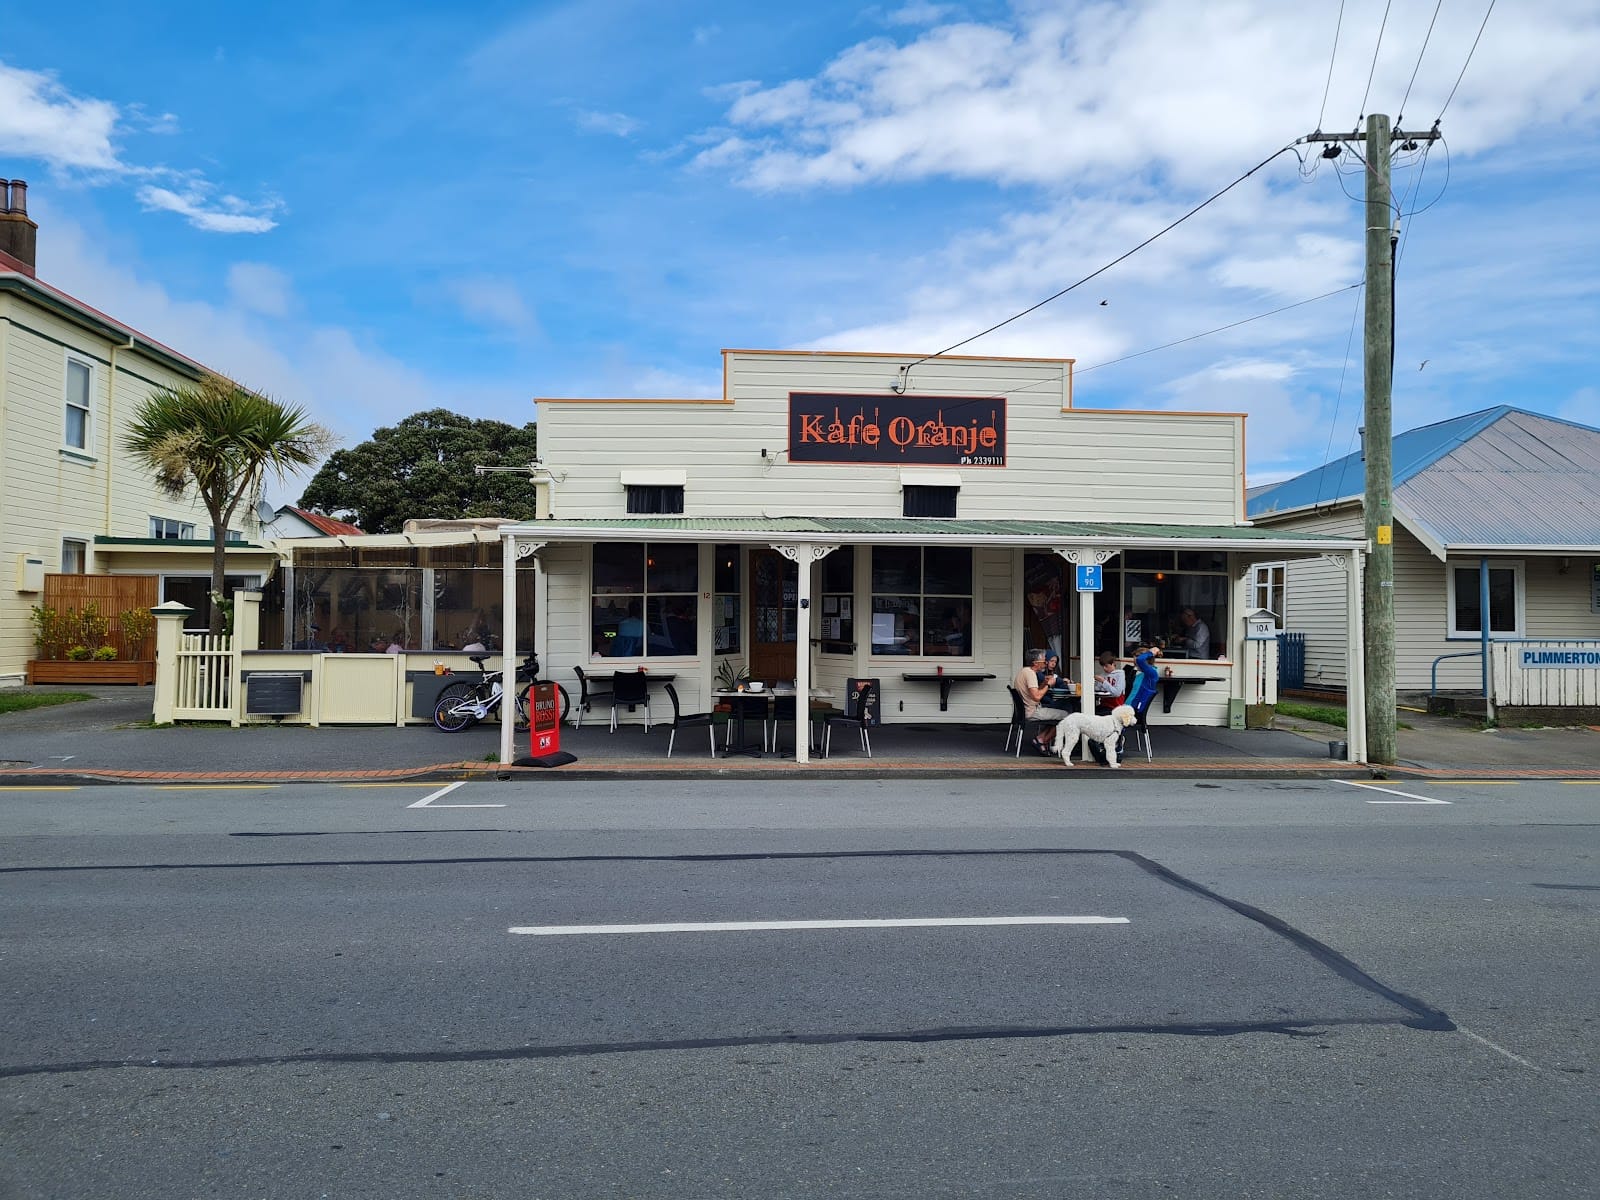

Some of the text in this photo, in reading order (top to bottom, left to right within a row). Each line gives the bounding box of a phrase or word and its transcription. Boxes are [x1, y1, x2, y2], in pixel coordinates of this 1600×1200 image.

[799, 409, 997, 453] Kafe Oranje
[960, 456, 1003, 465] Ph 2339111
[1086, 566, 1095, 577] P
[1084, 578, 1094, 586] 90
[1256, 624, 1268, 632] 10A
[535, 700, 555, 711] BRUNO
